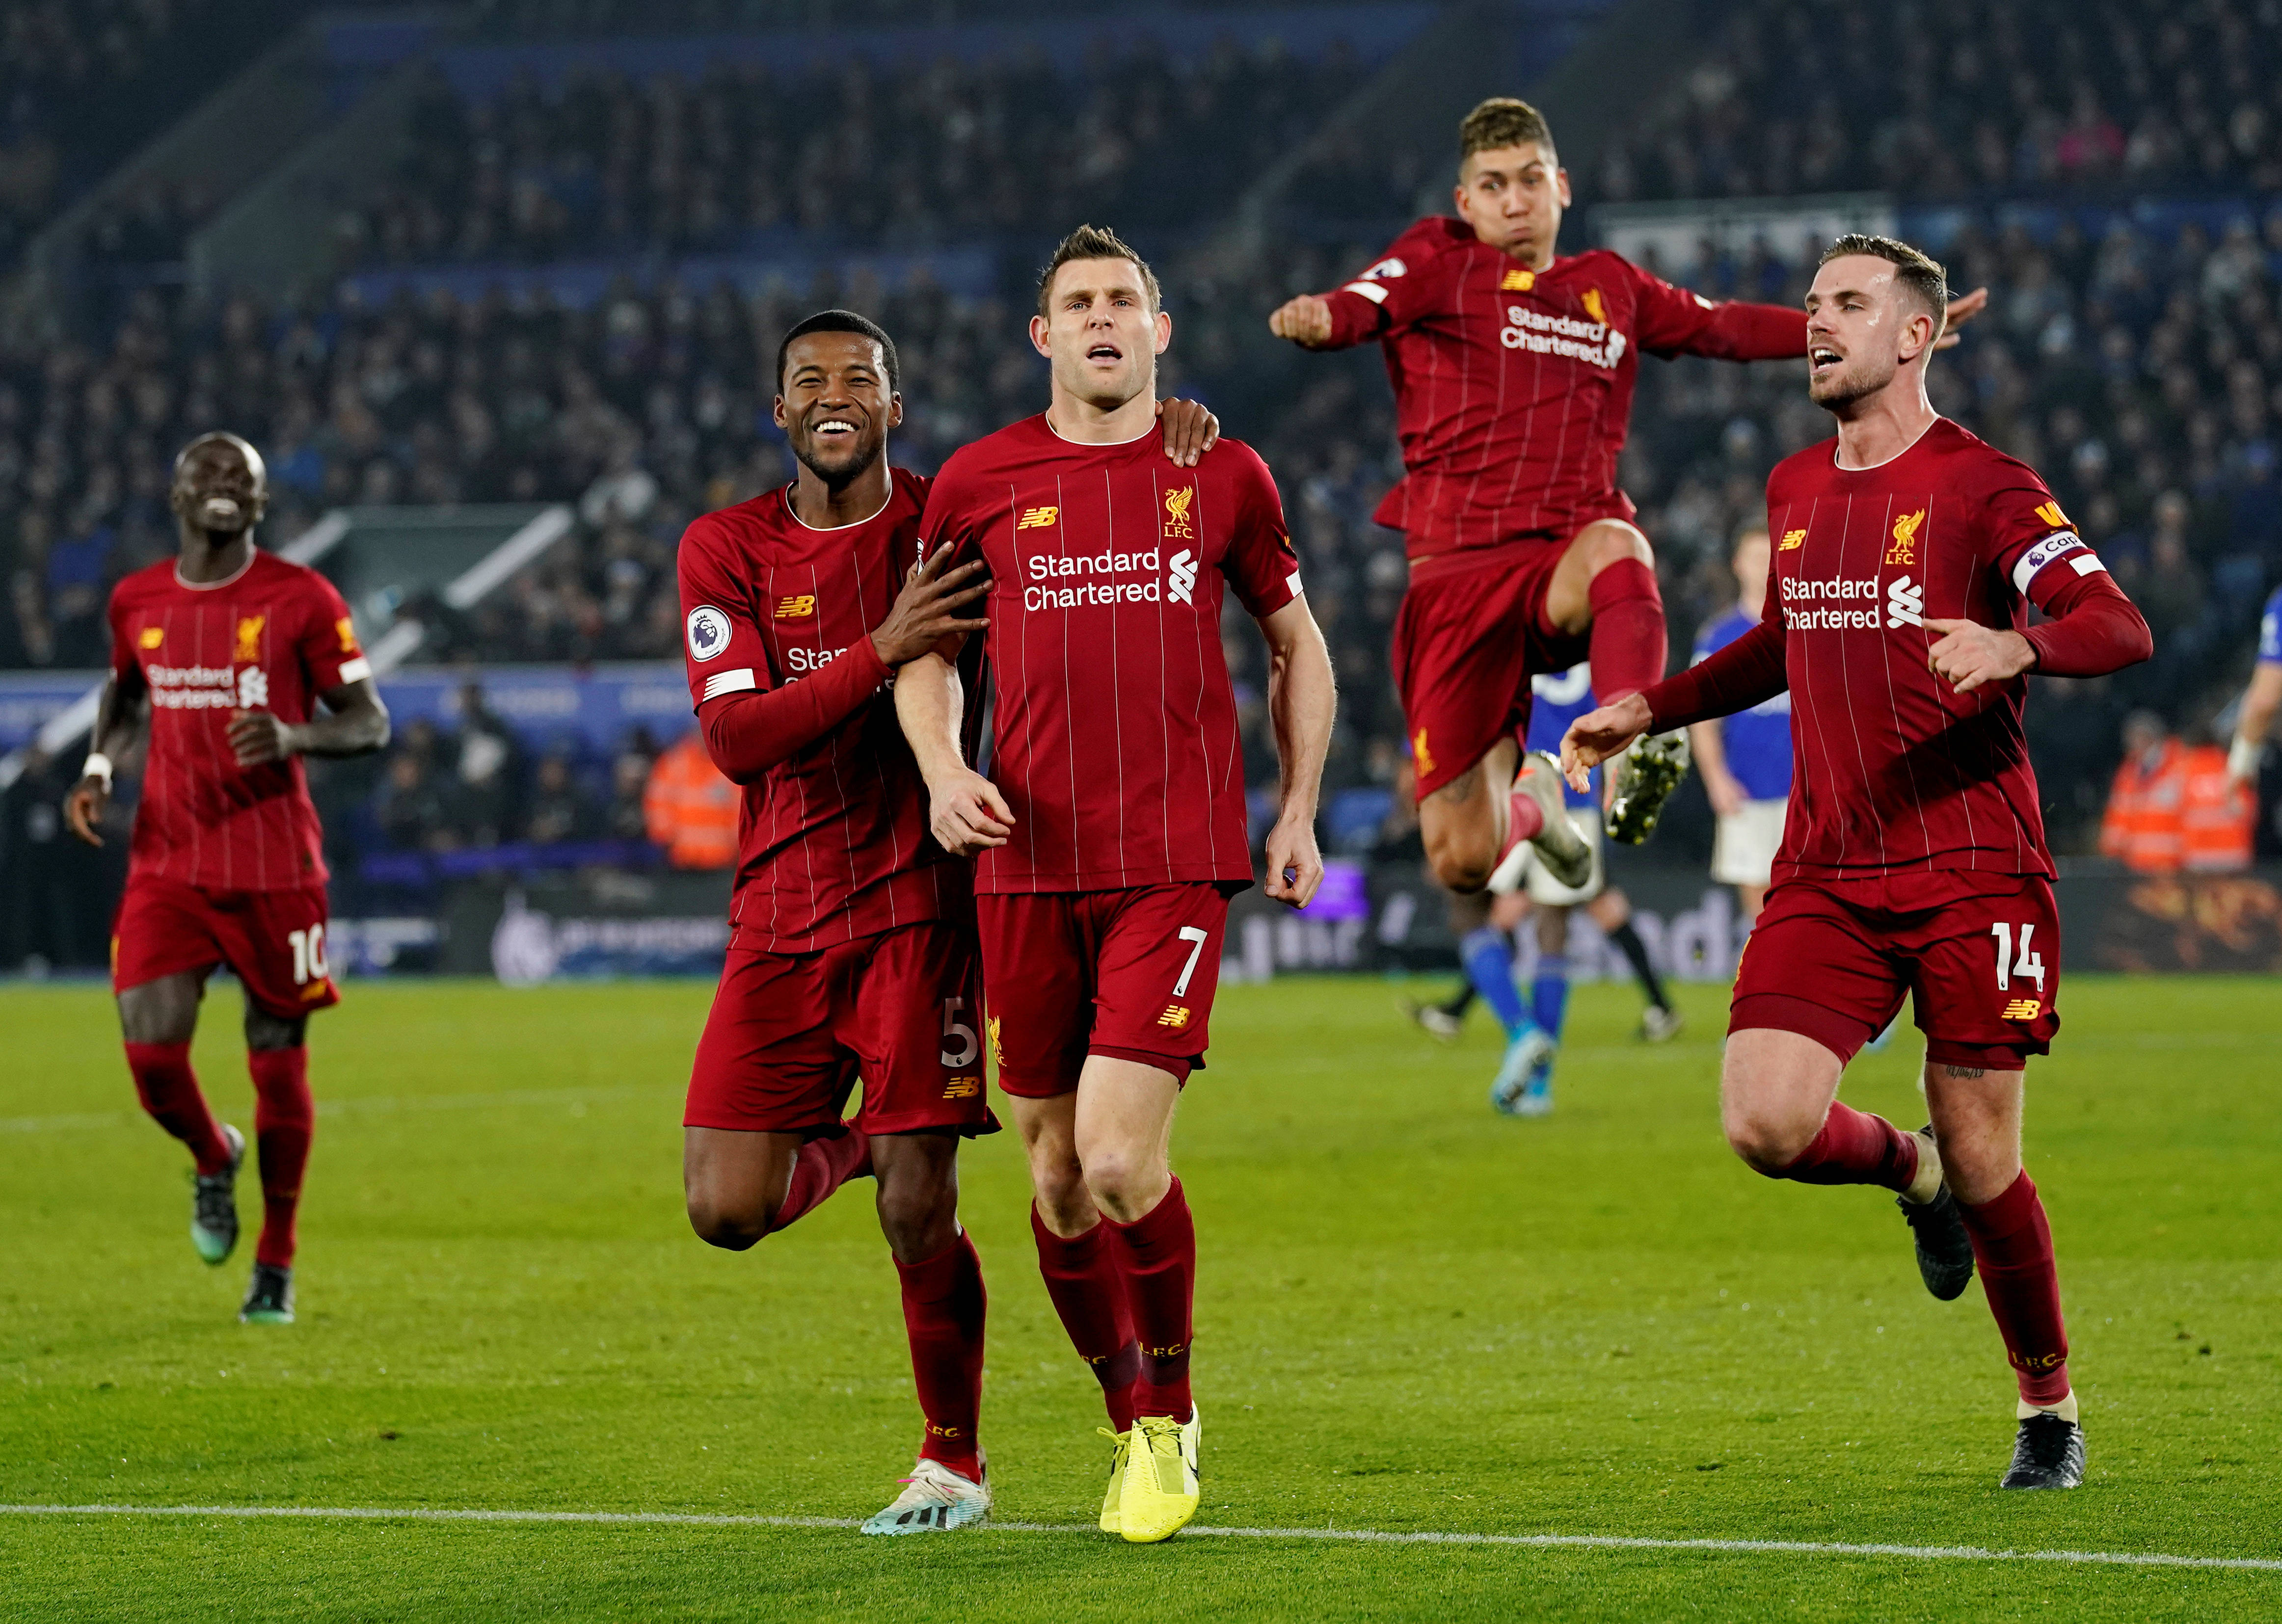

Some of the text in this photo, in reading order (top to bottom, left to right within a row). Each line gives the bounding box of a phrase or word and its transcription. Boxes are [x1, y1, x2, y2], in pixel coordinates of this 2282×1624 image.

[1507, 305, 1606, 342] Standard
[1500, 326, 1603, 367] Chartered
[1029, 547, 1160, 580] Standard
[1024, 577, 1160, 612] Chartered
[1782, 575, 1878, 601] Standard
[1782, 605, 1880, 631] Chartered
[287, 922, 329, 985] 10
[1172, 926, 1208, 997] 7
[1991, 922, 2045, 992] 14
[941, 996, 978, 1067] 5
